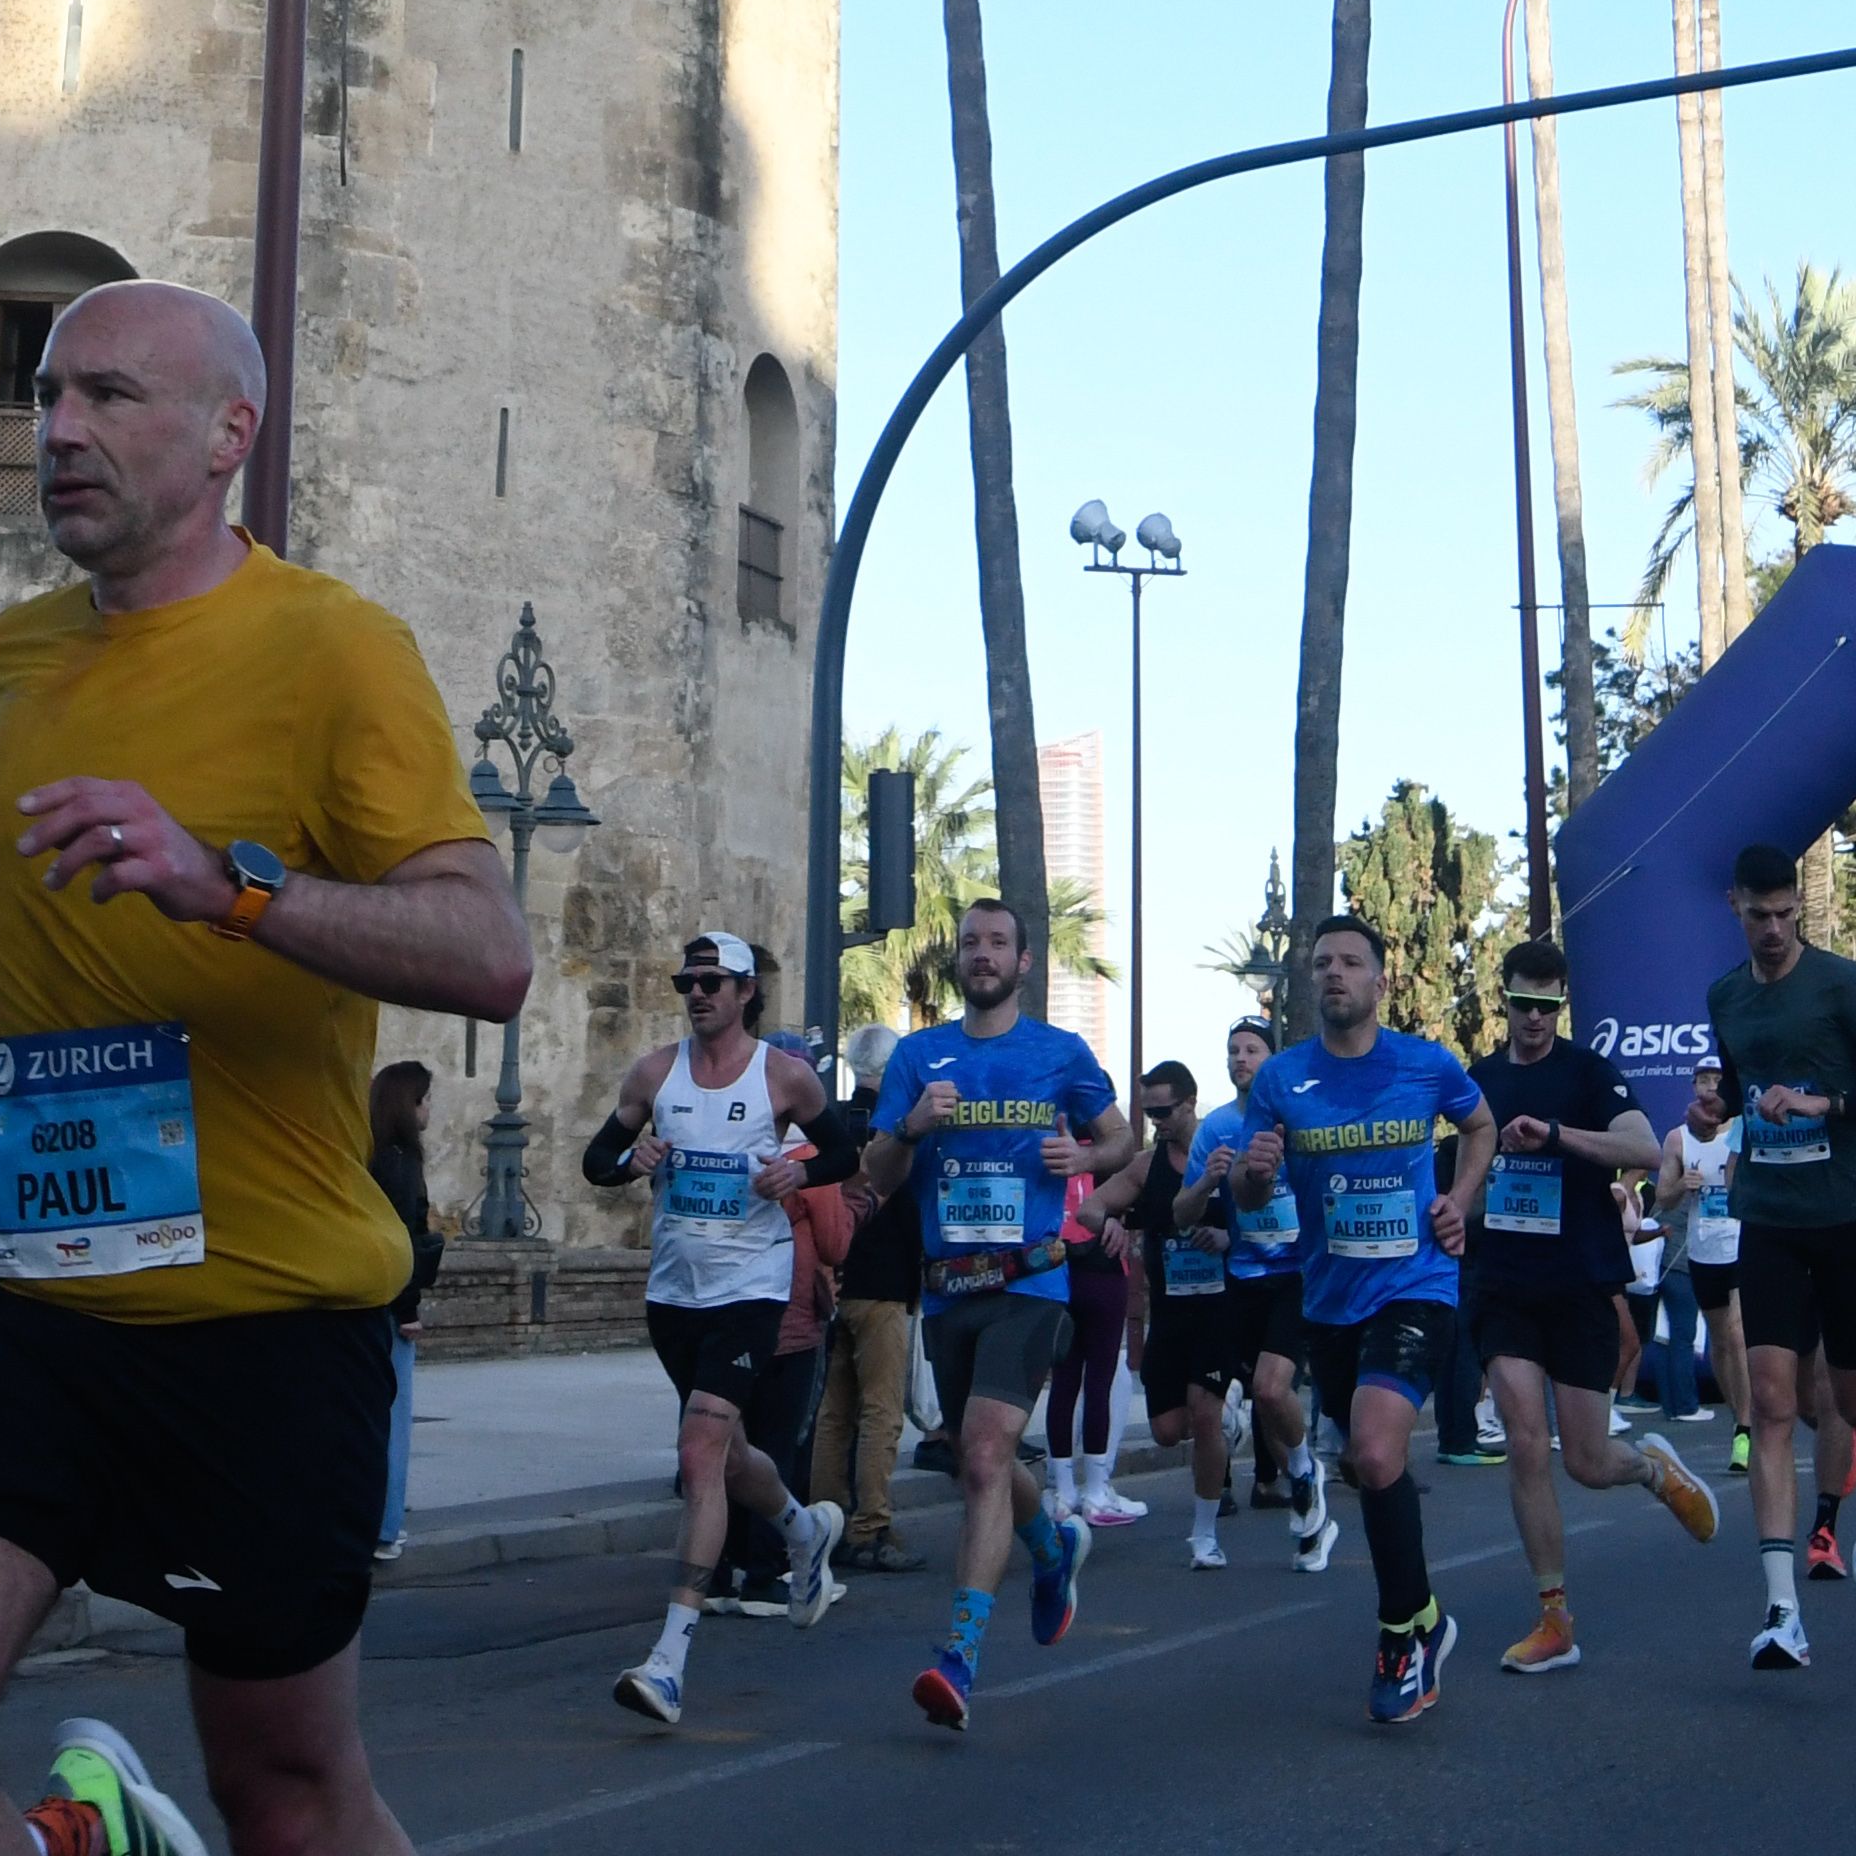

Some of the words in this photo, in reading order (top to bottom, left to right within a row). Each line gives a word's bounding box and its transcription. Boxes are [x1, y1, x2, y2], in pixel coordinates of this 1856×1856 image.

[1620, 1023, 1710, 1056] asics
[27, 1039, 155, 1081] ZURICH
[1647, 1065, 1673, 1077] mind,
[1675, 1066, 1694, 1076] sou
[33, 1119, 96, 1153] 6208
[690, 1155, 739, 1170] ZURICH
[965, 1162, 1014, 1174] ZURICH
[1509, 1159, 1552, 1172] ZURICH
[1352, 1175, 1403, 1190] ZURICH
[17, 1166, 128, 1220] PAUL
[945, 1204, 1015, 1222] RICARDO
[1355, 1204, 1383, 1215] 6157
[1333, 1218, 1409, 1238] ALBERTO
